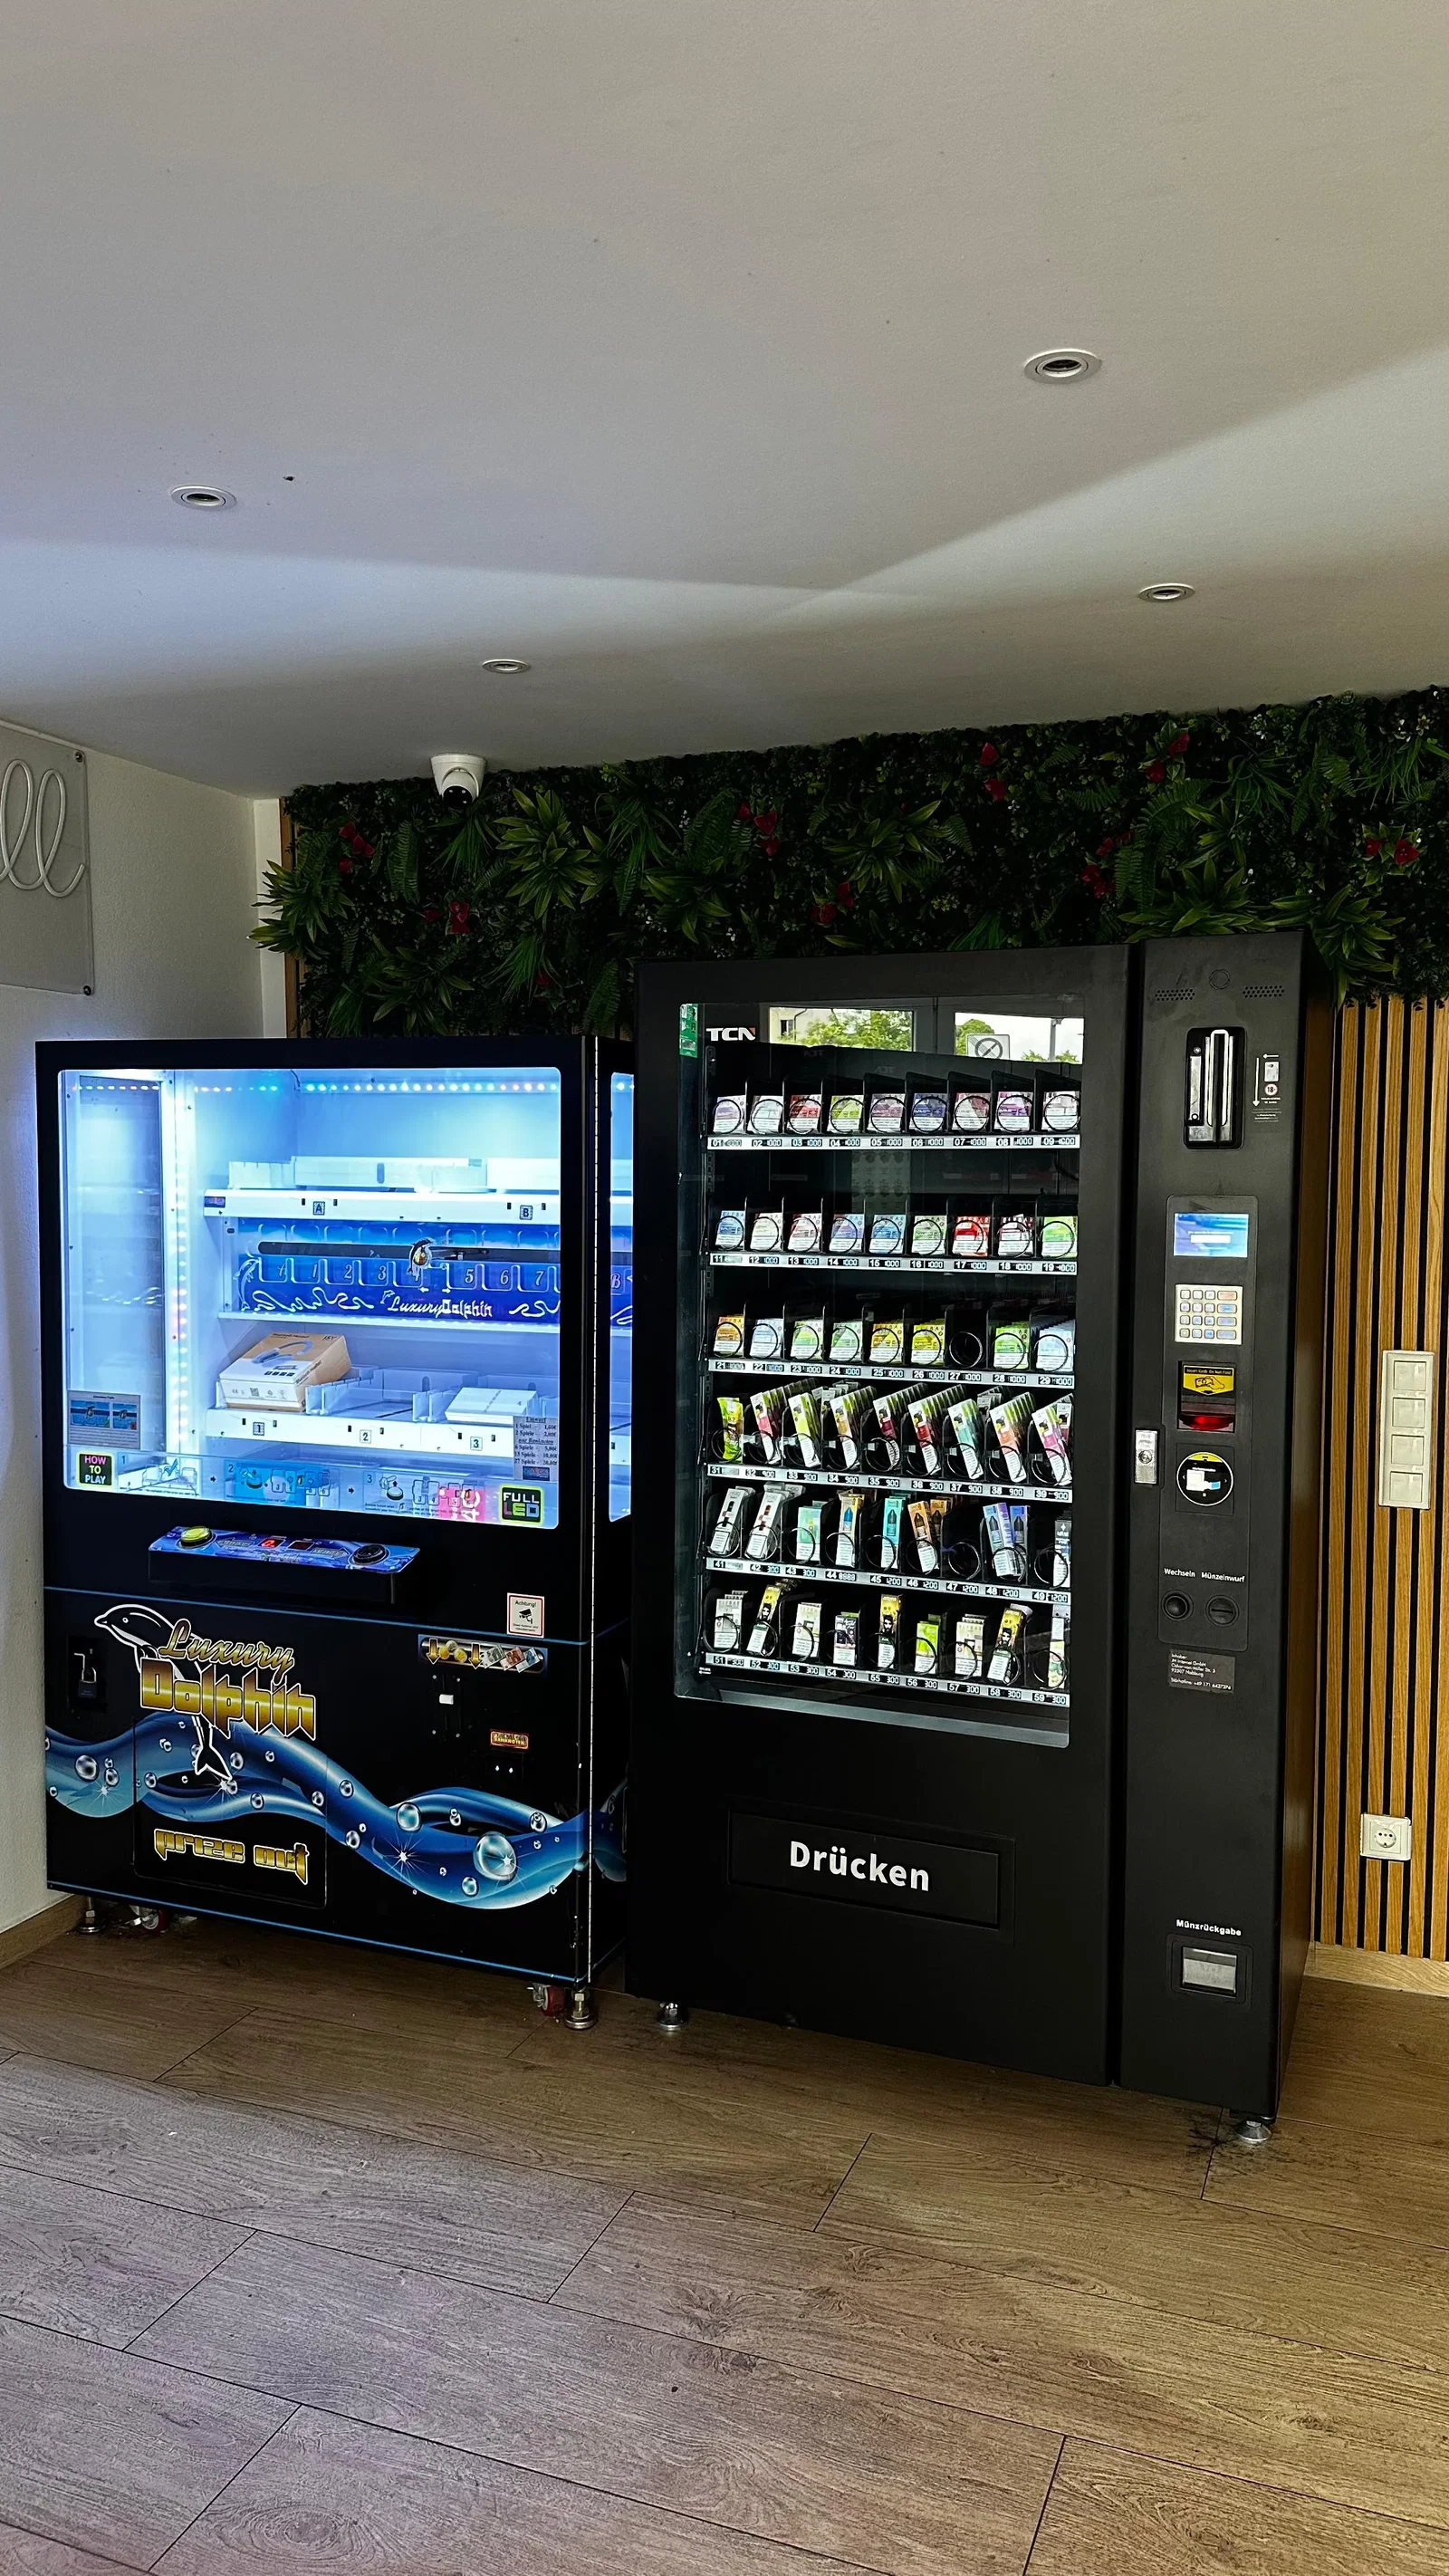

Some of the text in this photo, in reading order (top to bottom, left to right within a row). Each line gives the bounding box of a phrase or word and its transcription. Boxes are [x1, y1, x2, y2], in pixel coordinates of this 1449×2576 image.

[705, 1027, 756, 1042] TCN
[955, 1138, 965, 1146] 07
[998, 1138, 1009, 1146] 08
[84, 1456, 107, 1465] HOW
[89, 1465, 101, 1474] TO
[84, 1475, 106, 1485] PLAY
[503, 1492, 540, 1504] FULL
[504, 1504, 540, 1518] LED
[1164, 1568, 1245, 1582] Wechseln Münzeinwurf
[515, 1600, 536, 1608] Achtung!
[158, 1619, 294, 1685] Luxury
[140, 1657, 316, 1741] Dolphin
[154, 1828, 310, 1885] prize out
[790, 1840, 929, 1892] Drücken
[1176, 1919, 1242, 1937] Münzrückgabe
